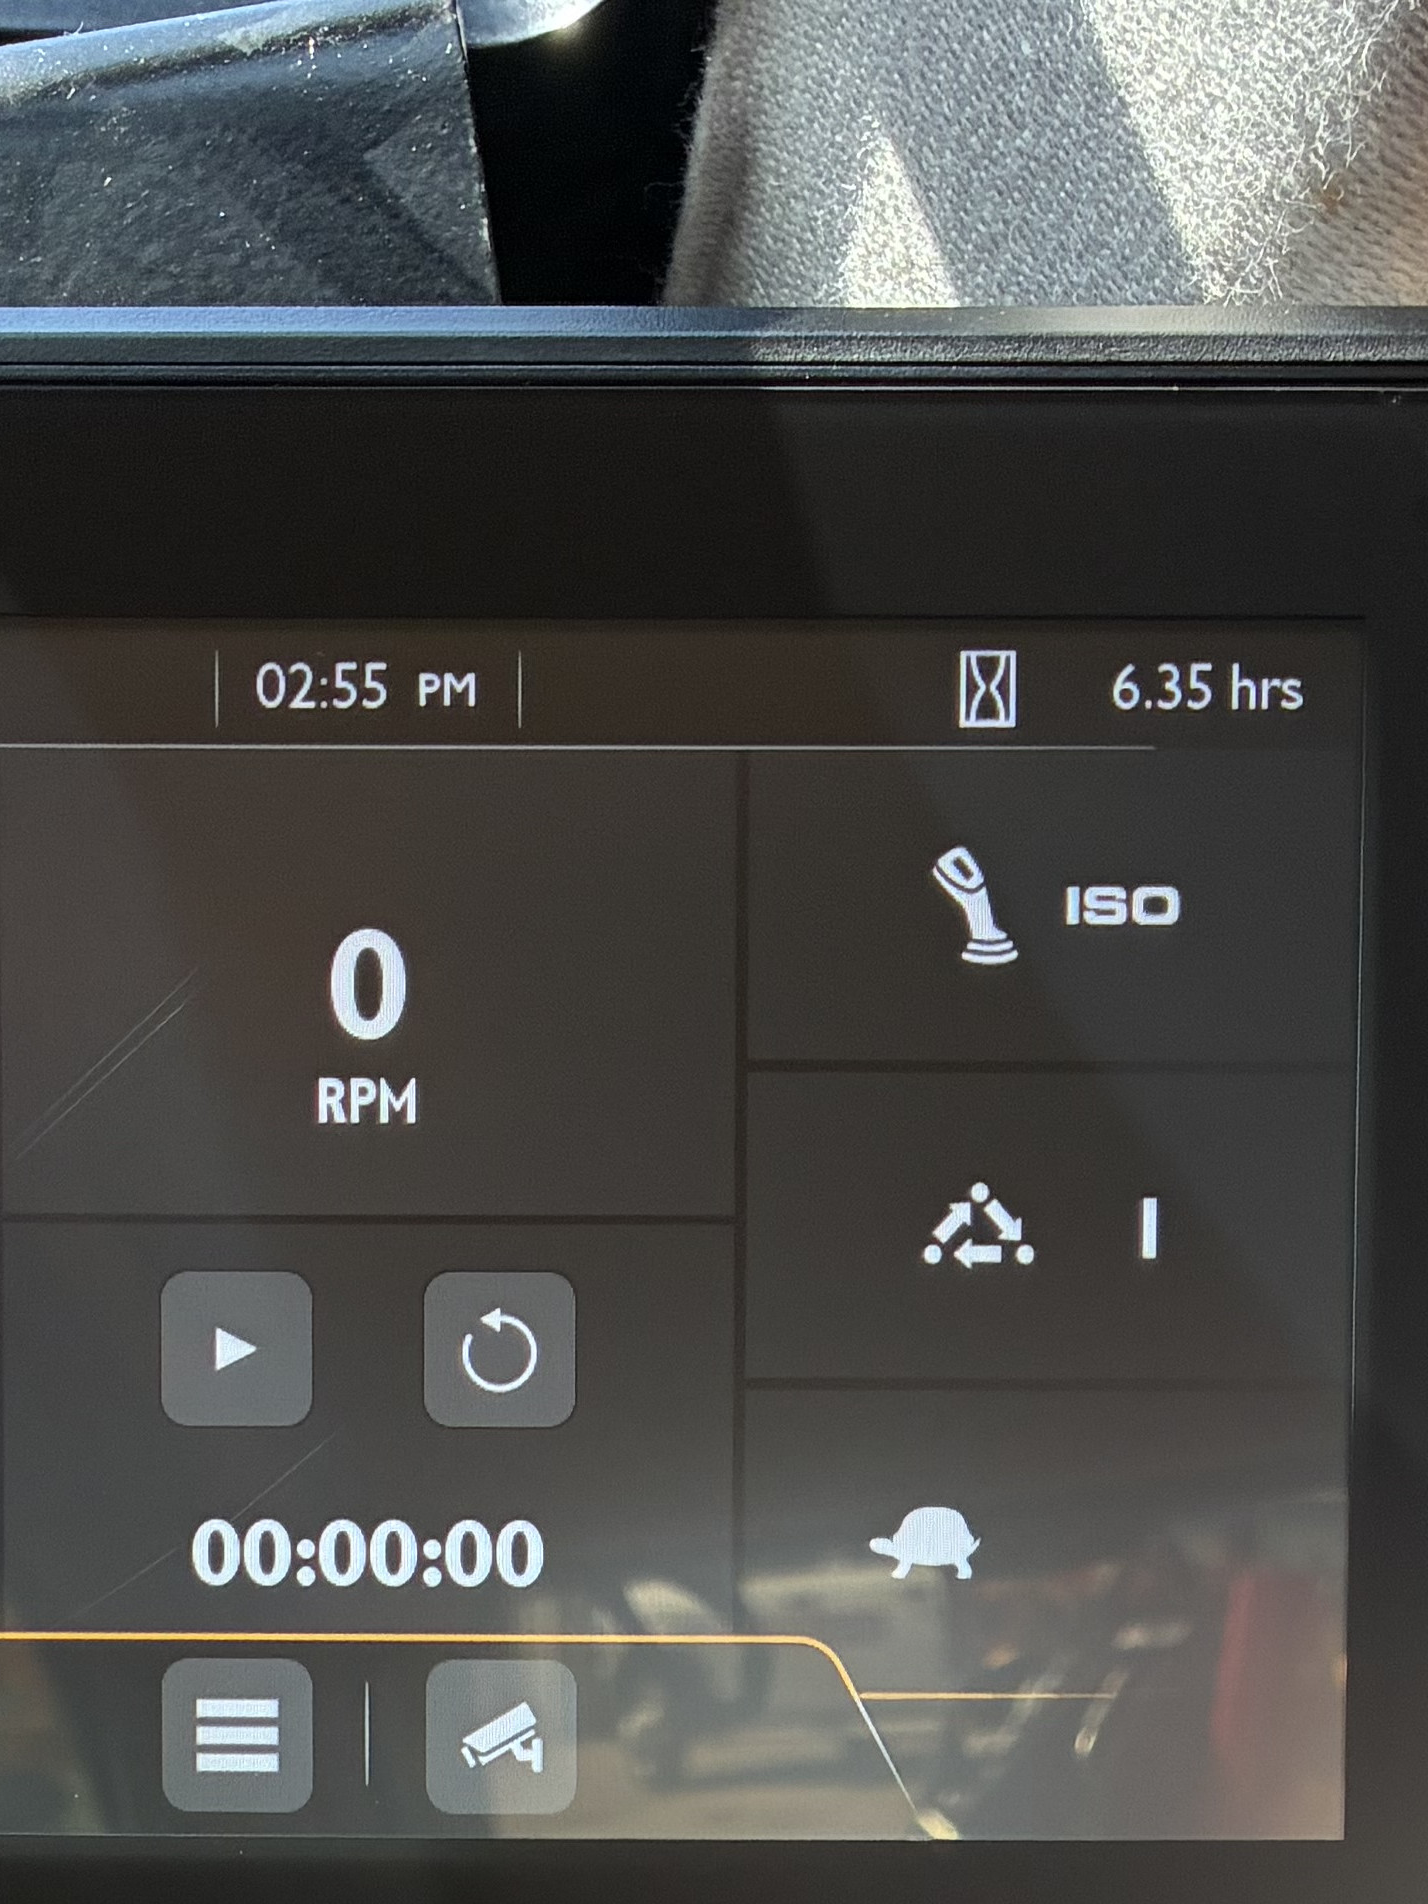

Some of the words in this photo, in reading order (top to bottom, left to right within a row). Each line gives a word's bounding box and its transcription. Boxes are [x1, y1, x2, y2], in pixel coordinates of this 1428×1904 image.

[256, 661, 388, 710] 02:55
[418, 672, 477, 707] PM
[1112, 662, 1213, 711] 6.35
[1231, 662, 1304, 711] hrs
[1064, 886, 1182, 927] ISO
[330, 928, 407, 1041] 0
[317, 1077, 418, 1124] RPM
[191, 1518, 545, 1588] 00:00:00
